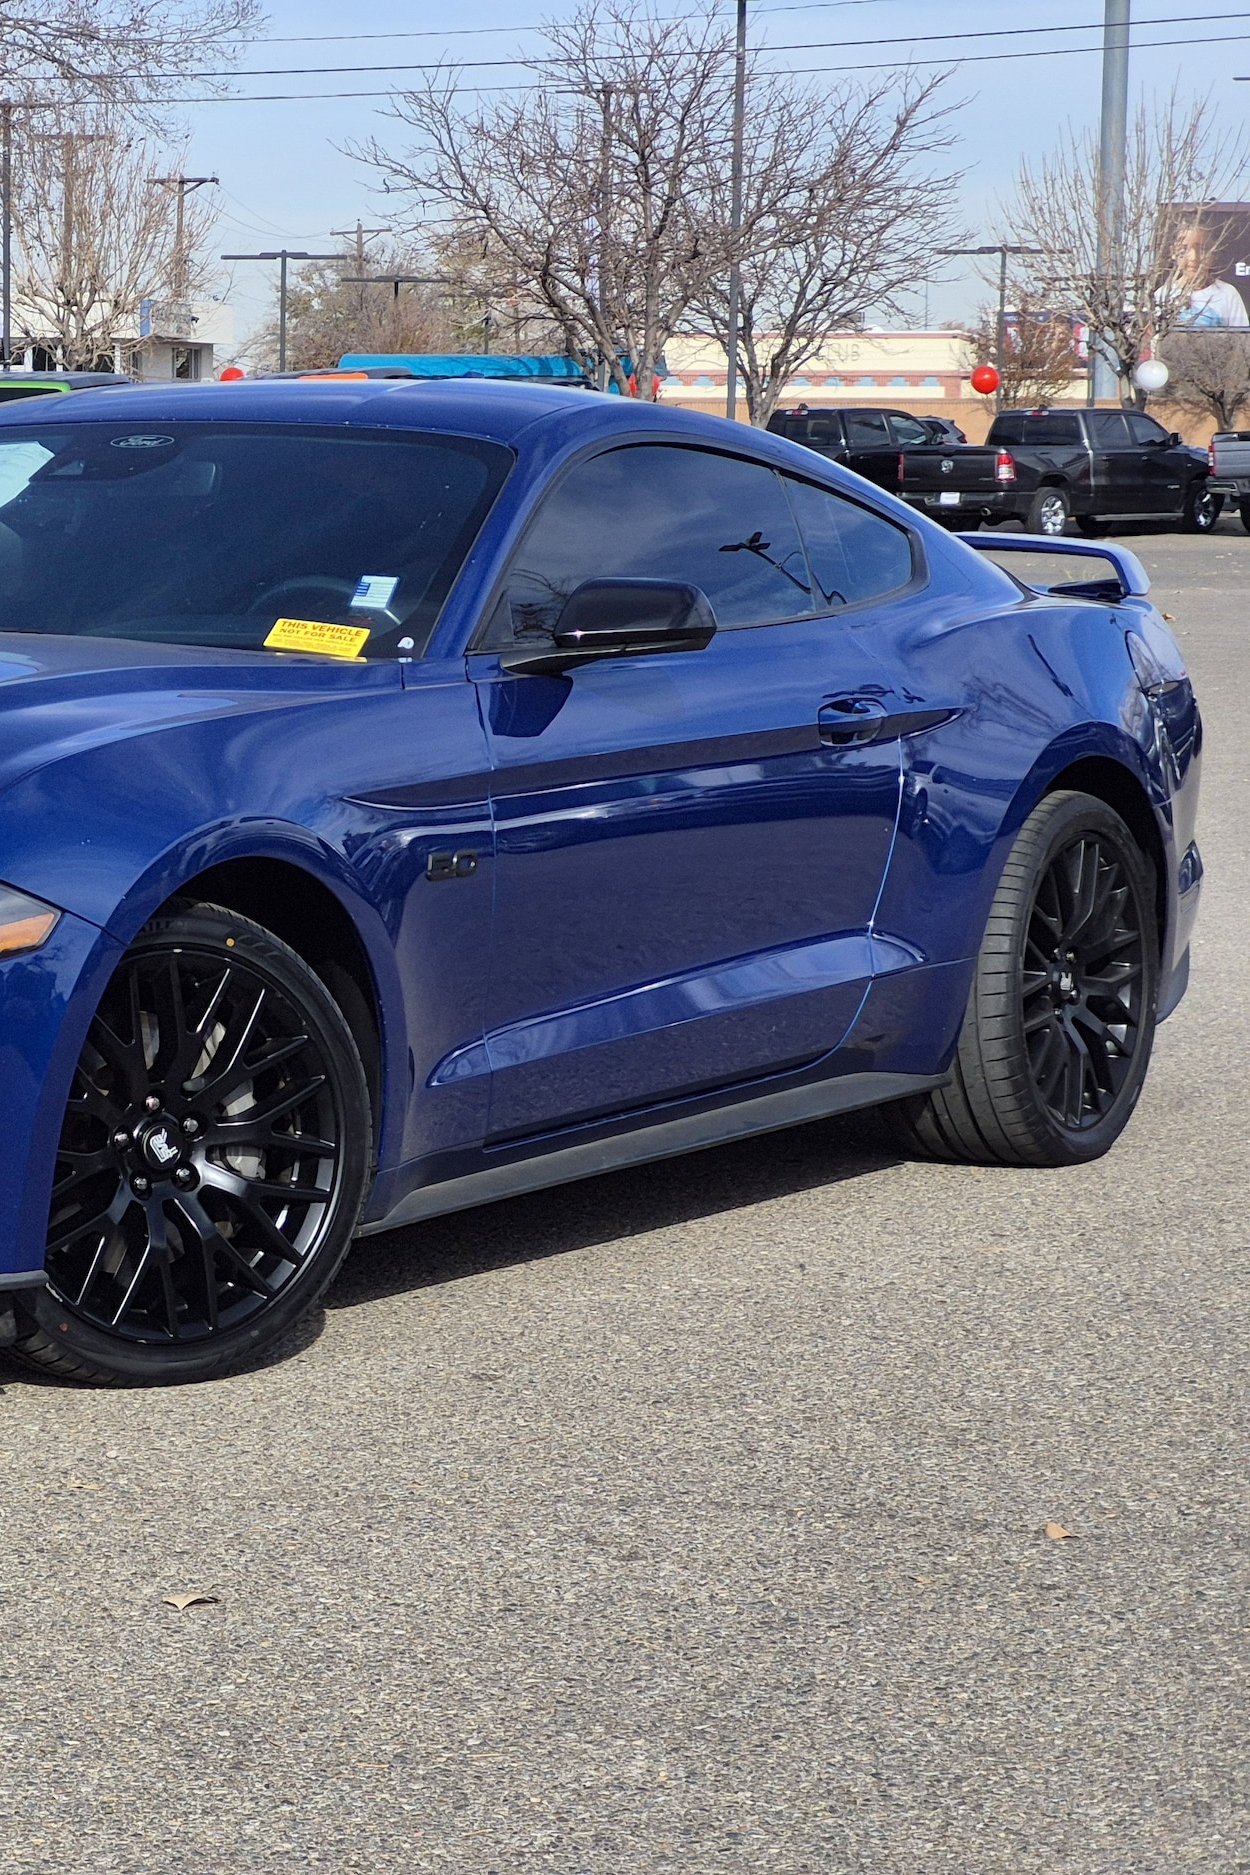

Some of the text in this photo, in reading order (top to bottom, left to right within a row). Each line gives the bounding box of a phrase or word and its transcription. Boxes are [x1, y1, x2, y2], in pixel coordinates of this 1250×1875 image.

[820, 343, 860, 362] LUB
[117, 435, 167, 447] Ford
[281, 620, 364, 637] THIS VEHICLE
[328, 634, 358, 643] SALE
